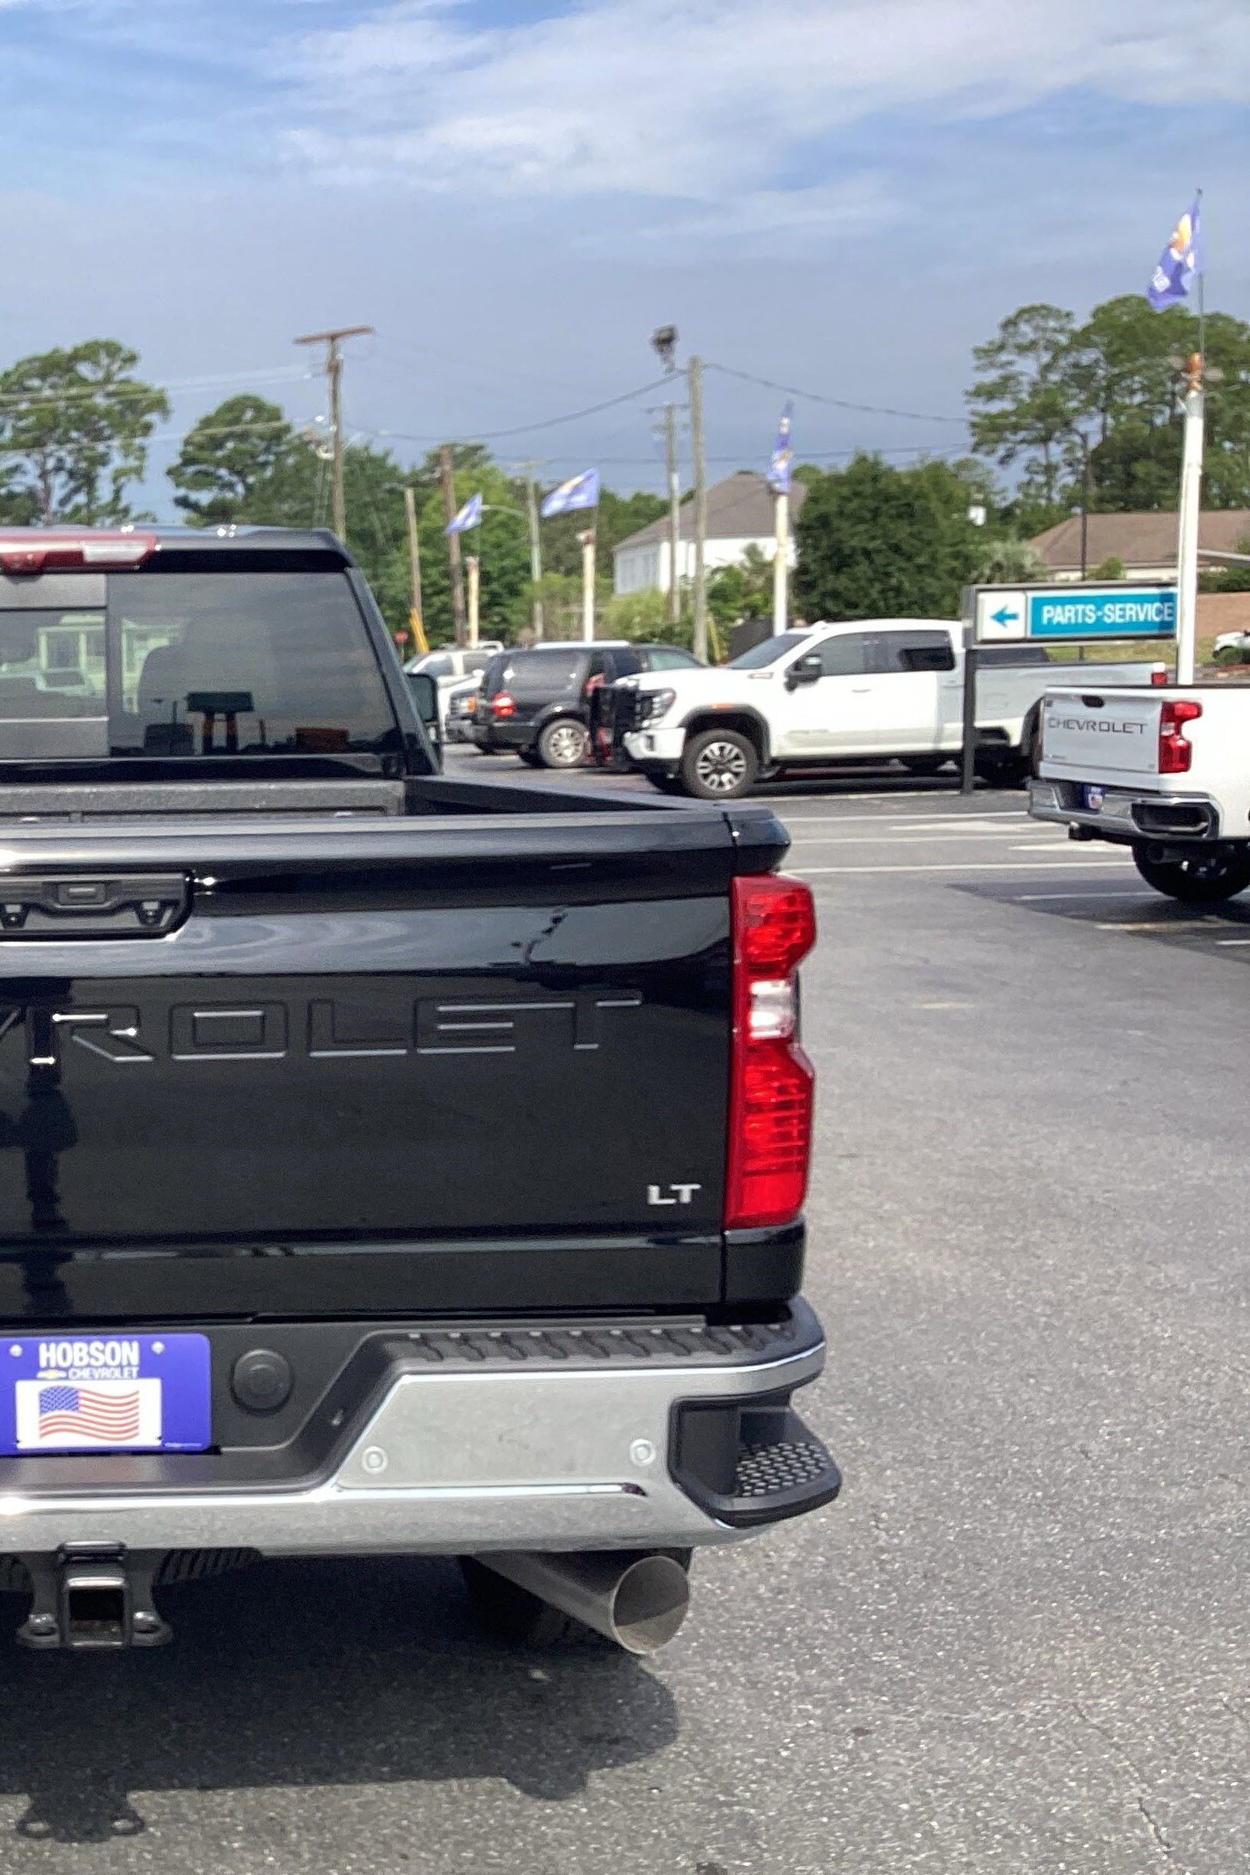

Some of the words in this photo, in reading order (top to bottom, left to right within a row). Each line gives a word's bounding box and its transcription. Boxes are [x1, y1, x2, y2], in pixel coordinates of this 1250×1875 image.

[1048, 717, 1147, 734] CHEVROLET
[648, 1184, 702, 1205] LT
[39, 1341, 139, 1368] HOBSON
[68, 1367, 139, 1380] CHEVROLET
